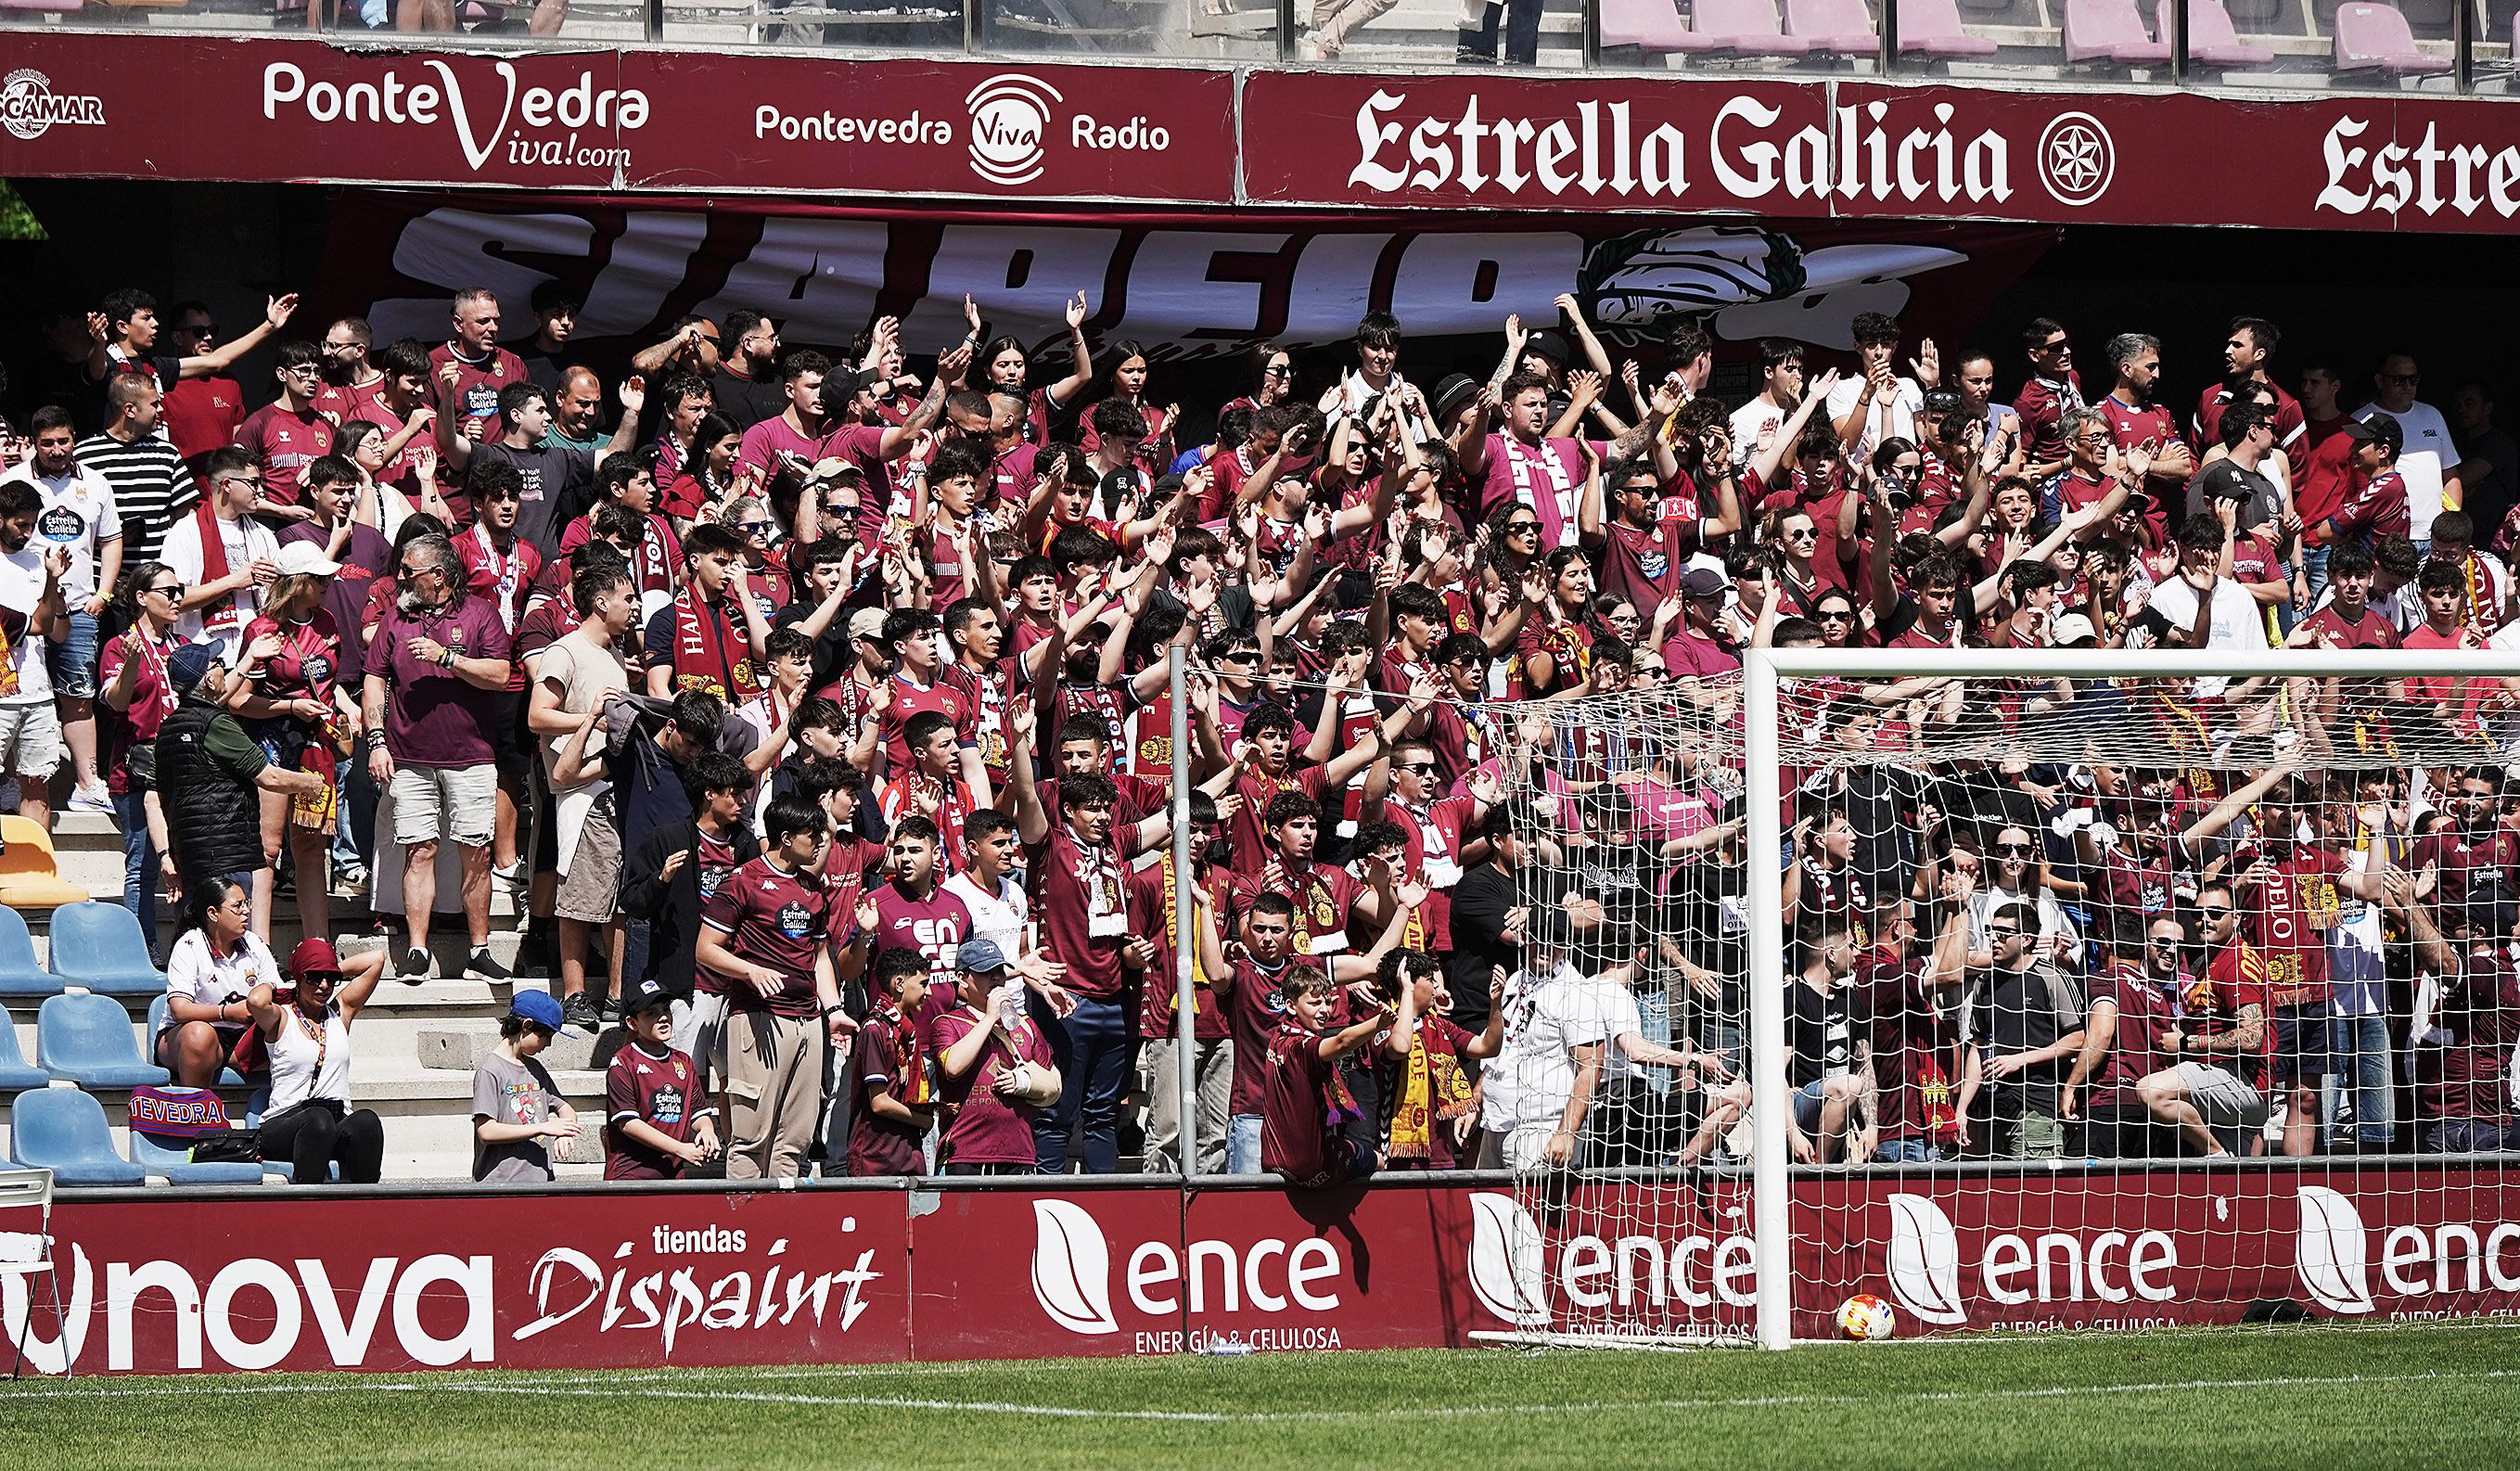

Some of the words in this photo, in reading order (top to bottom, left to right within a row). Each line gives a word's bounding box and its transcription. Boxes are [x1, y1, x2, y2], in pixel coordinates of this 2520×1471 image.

[757, 106, 953, 144] Pontevedra
[977, 111, 1040, 147] Viva
[1072, 115, 1170, 151] Radio
[1348, 88, 1691, 198] Estrella
[1709, 95, 2014, 205] Galicia
[2314, 115, 2520, 219] Estre
[467, 390, 498, 400] Estrella
[469, 399, 497, 409] Galicia
[46, 515, 79, 526] Estrella
[47, 525, 78, 535] Galicia
[680, 611, 705, 656] HAI
[2474, 870, 2503, 880] Estrella
[782, 909, 811, 920] Estrella
[783, 919, 807, 929] Galicia
[655, 1094, 683, 1104] Estrella
[657, 1103, 682, 1114] Galicia
[652, 1224, 747, 1254] tiendas
[1127, 1238, 1340, 1314] ence
[1561, 1234, 1758, 1308] ence
[1983, 1230, 2179, 1305] ence
[512, 1237, 885, 1360] Dispaint
[1249, 1327, 1342, 1351] CELULOSA
